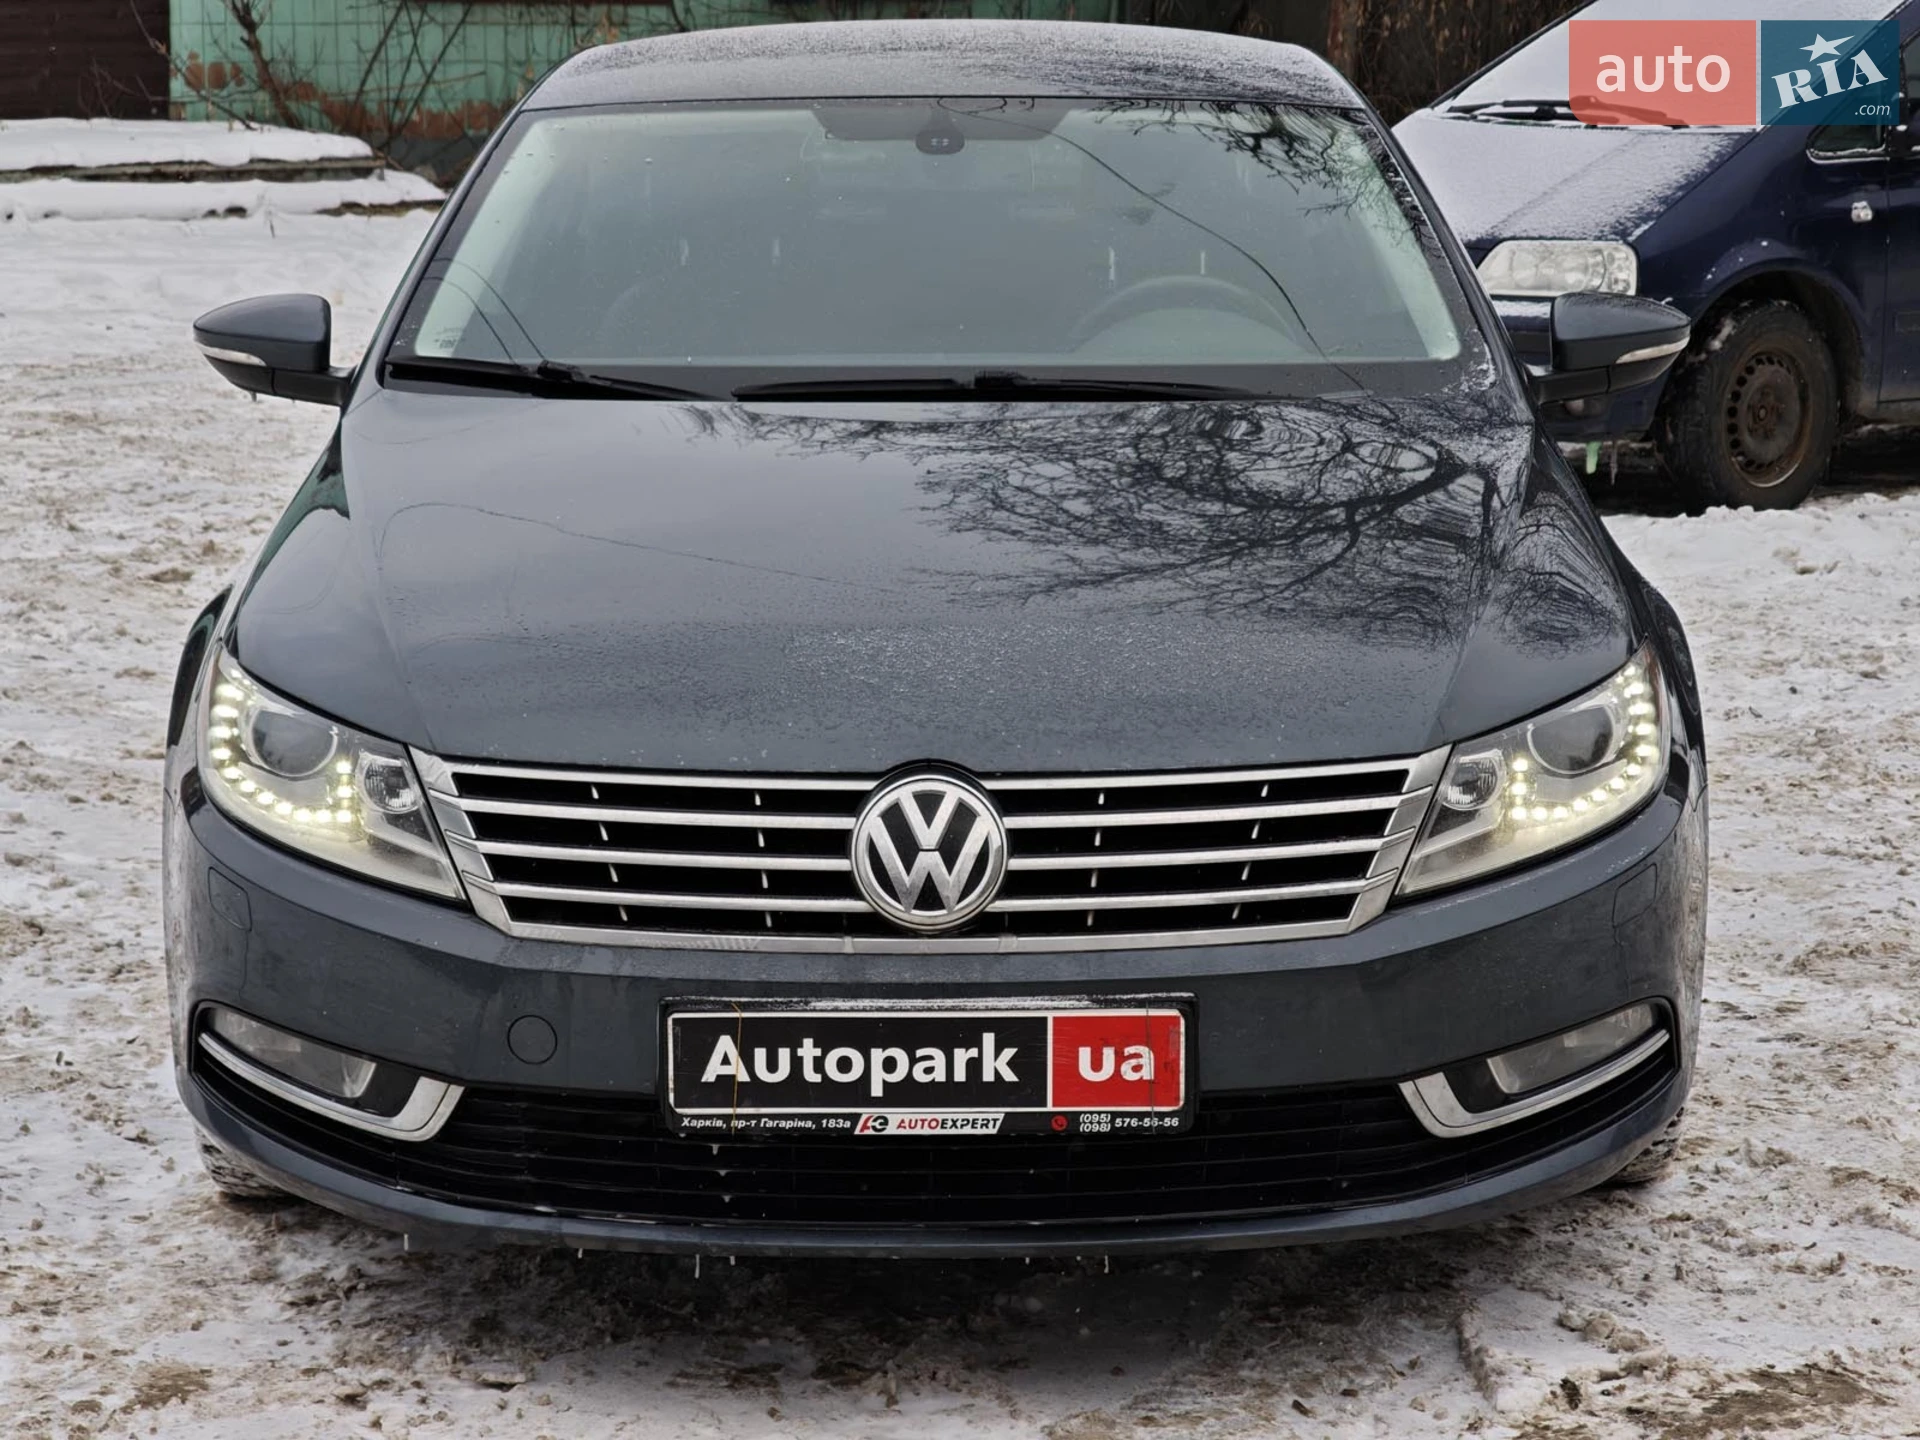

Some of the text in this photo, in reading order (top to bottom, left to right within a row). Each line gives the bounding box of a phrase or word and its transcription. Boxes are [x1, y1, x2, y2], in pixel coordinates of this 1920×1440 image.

[862, 779, 996, 917] VW
[700, 1032, 1156, 1098] Autopark ua
[681, 1117, 727, 1129] Харків,
[731, 1118, 757, 1129] пр-т
[760, 1117, 816, 1130] Гагаріна,
[896, 1117, 1001, 1130] AUTOEXPERT
[1080, 1113, 1111, 1123] (095)
[1114, 1117, 1180, 1128] 576-56-56
[1080, 1123, 1111, 1133] (098)
